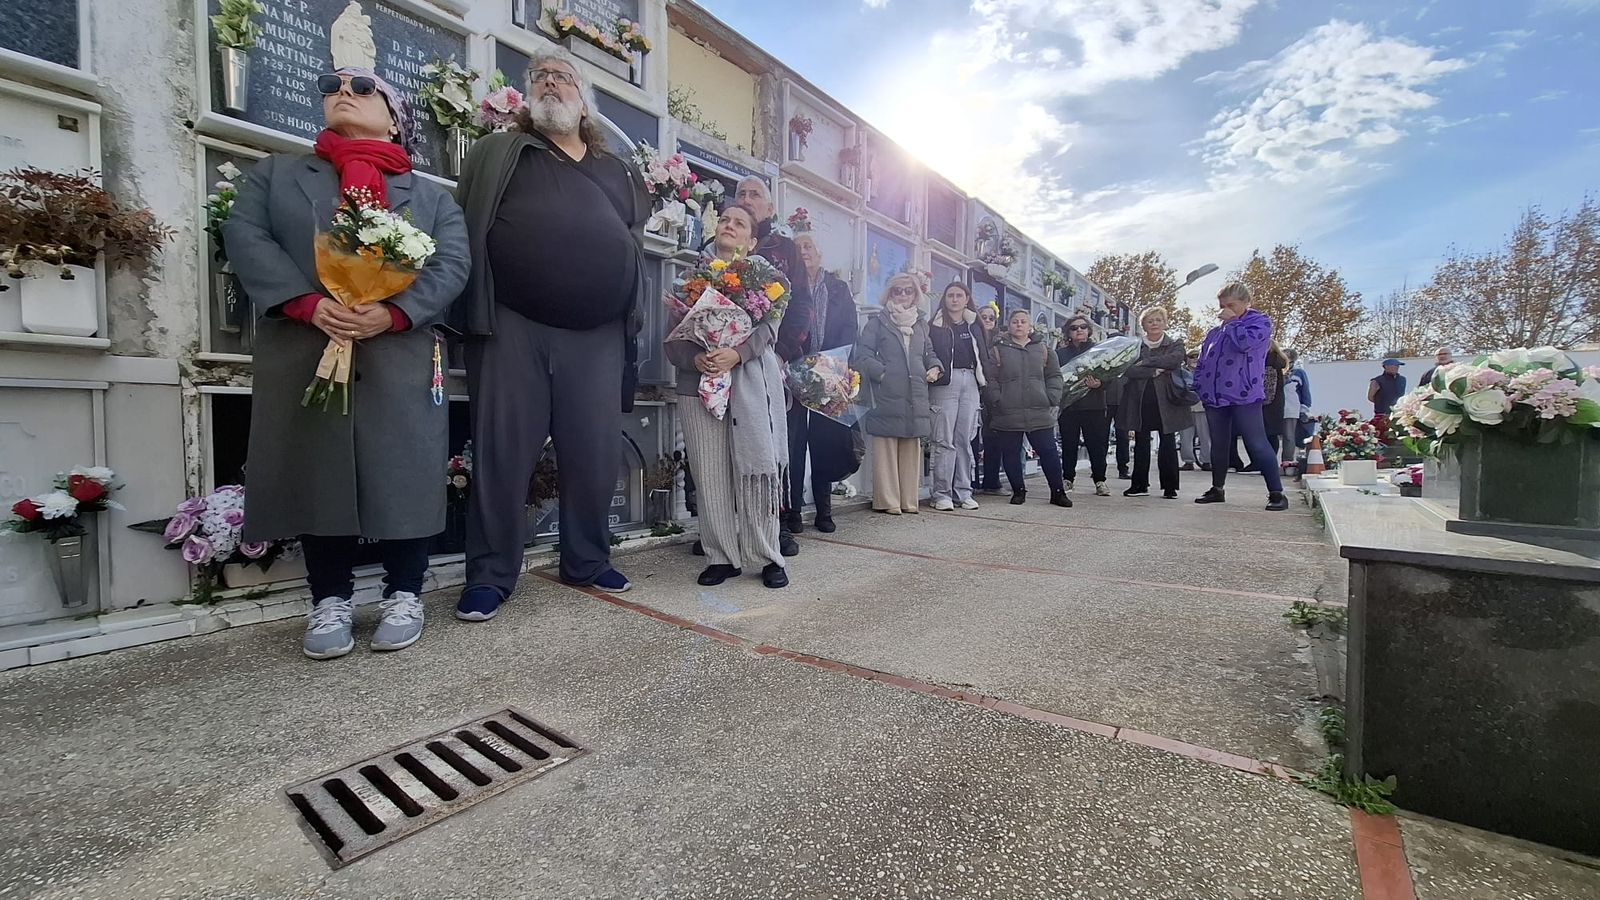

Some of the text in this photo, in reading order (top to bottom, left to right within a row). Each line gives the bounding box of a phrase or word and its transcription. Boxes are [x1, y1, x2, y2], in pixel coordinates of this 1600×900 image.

[265, 22, 314, 50] MUÑOZ
[283, 11, 326, 38] MARIA
[255, 36, 324, 71] MARTINEZ
[392, 39, 427, 62] D. E. P.
[276, 75, 306, 92] A LOS
[270, 86, 313, 108] 76 AÑOS
[264, 109, 285, 124] SUS
[287, 116, 318, 133] HIJOS
